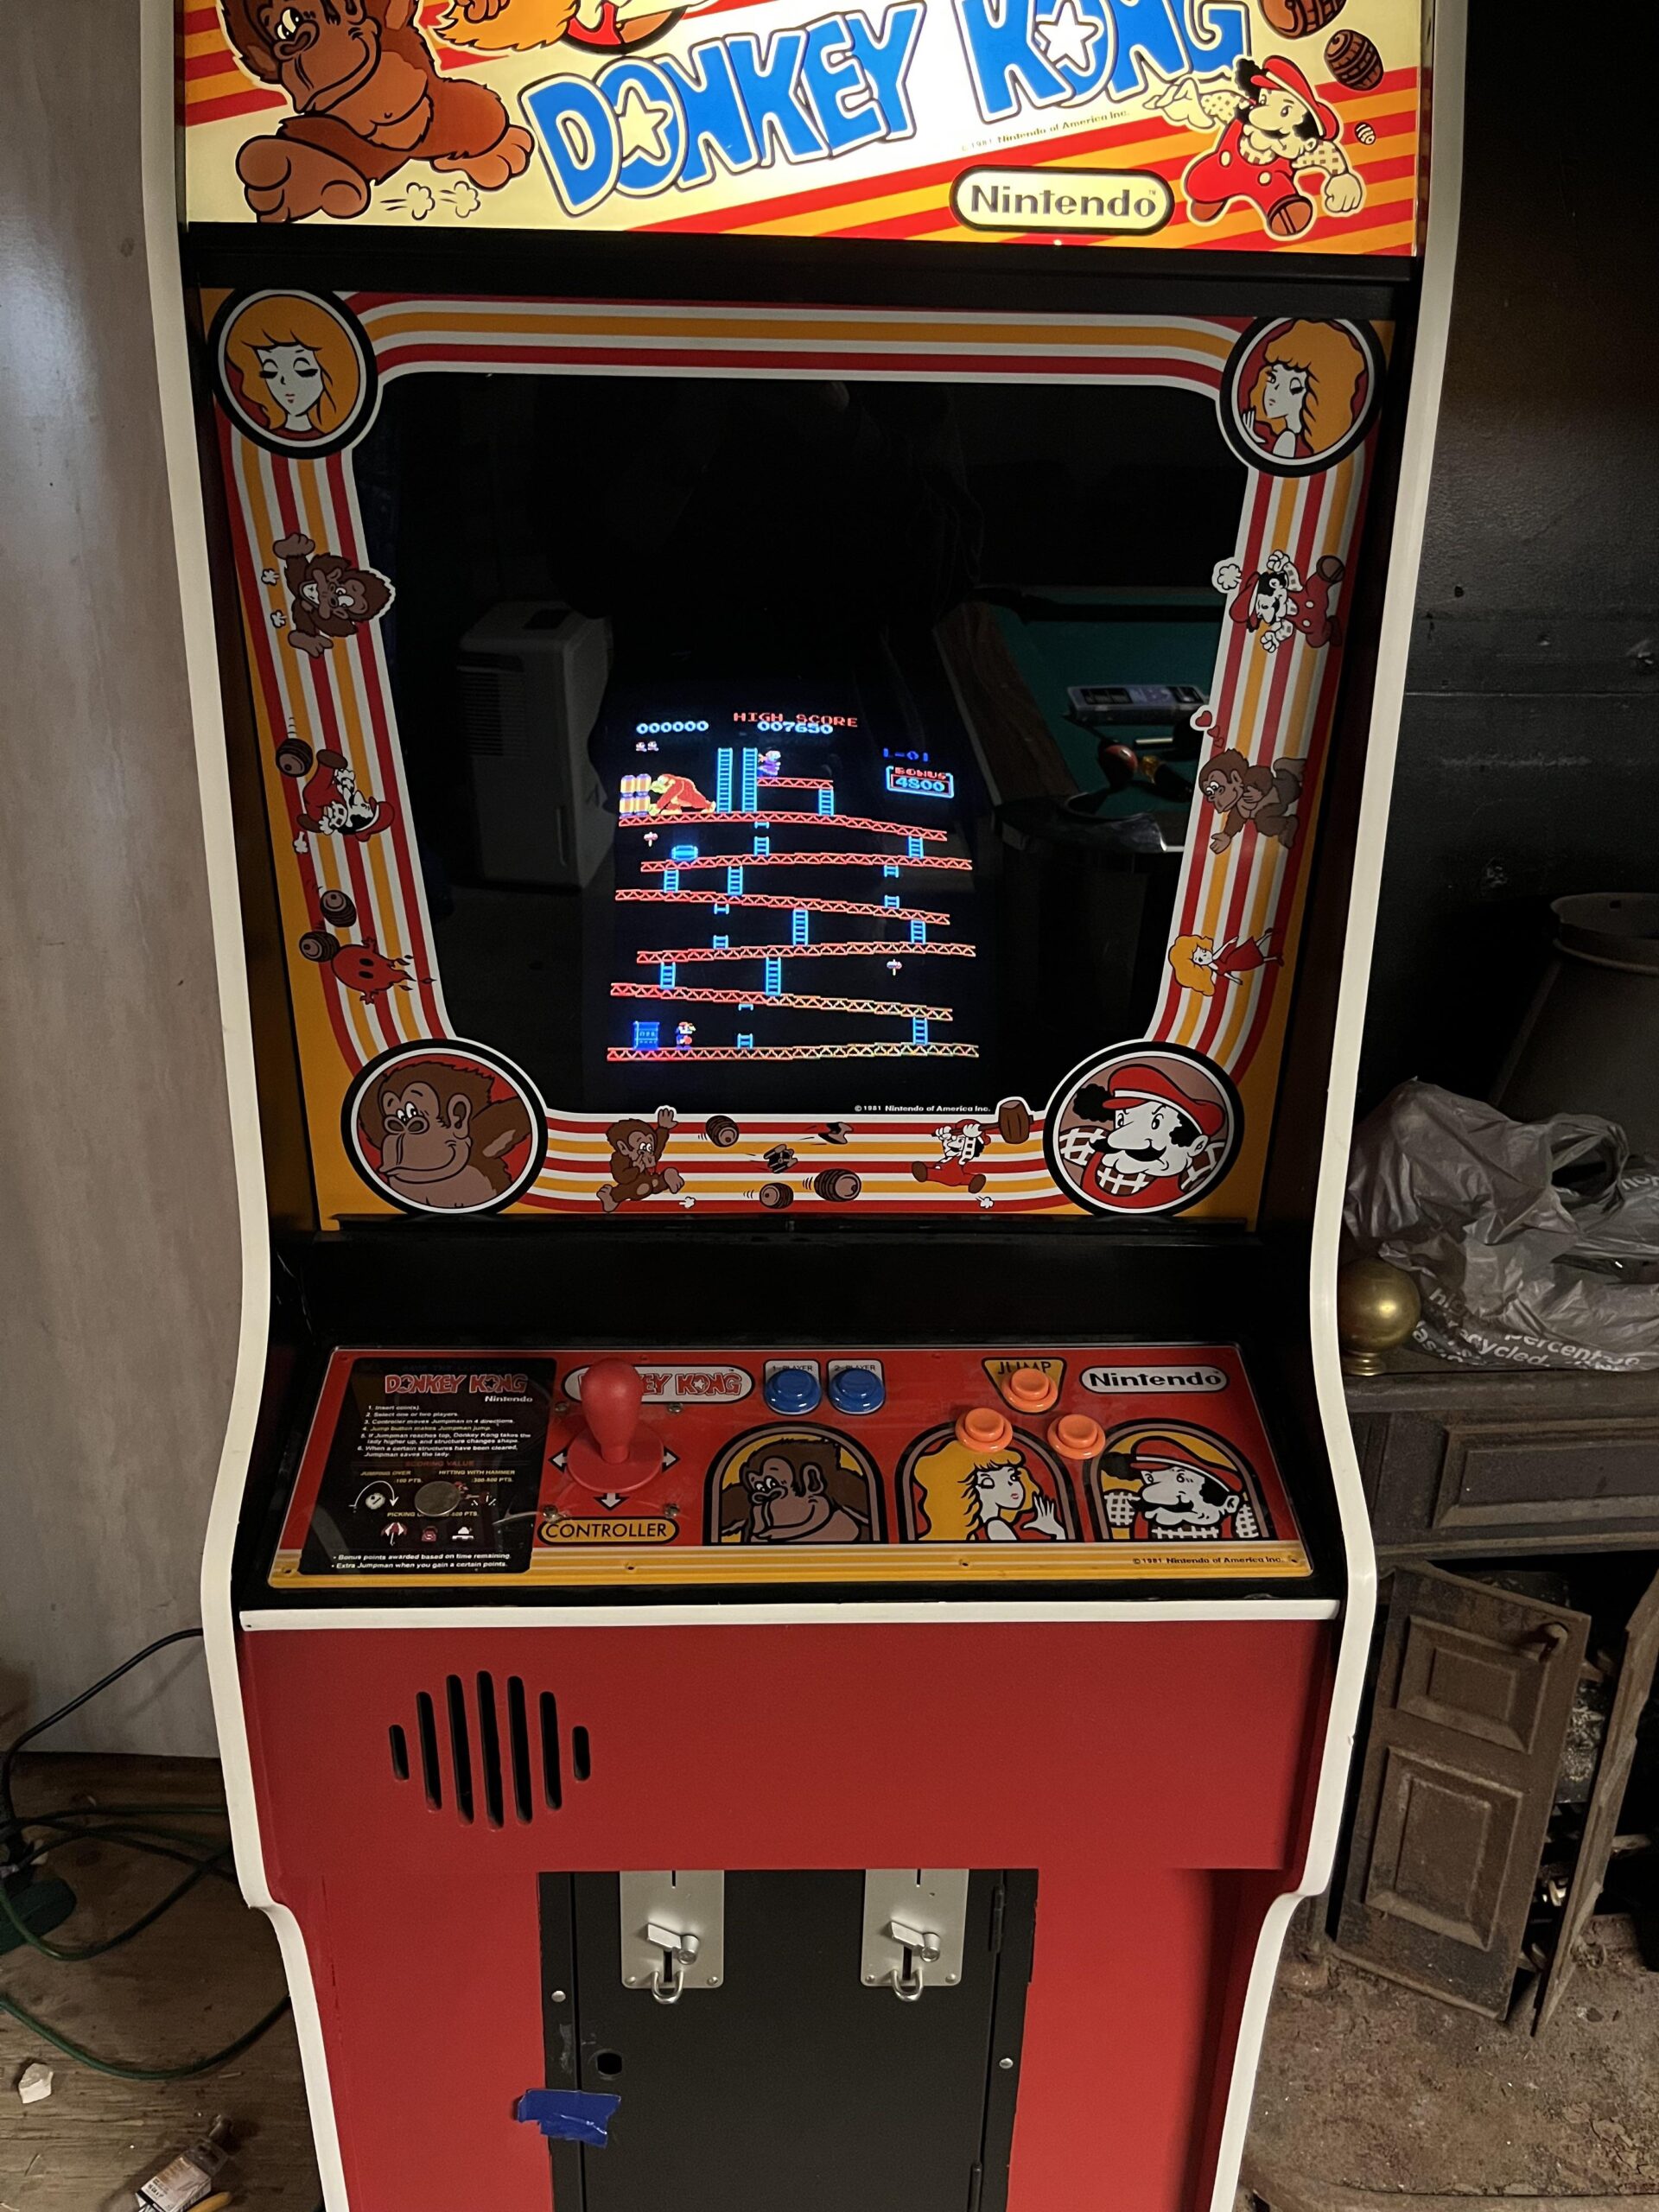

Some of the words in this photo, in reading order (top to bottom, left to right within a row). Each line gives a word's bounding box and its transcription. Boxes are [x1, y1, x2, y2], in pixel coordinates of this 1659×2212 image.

[521, 0, 927, 219] DONKEY
[955, 0, 1249, 124] KONG
[997, 128, 1046, 143] Nintendo
[1050, 123, 1059, 132] of
[1062, 114, 1108, 130] America
[969, 185, 1156, 219] Nintendo
[636, 721, 709, 734] 000000
[733, 712, 784, 724] HIGH
[796, 713, 858, 728] SCORE
[757, 720, 834, 734] 007650
[894, 766, 946, 780] BONUS
[385, 1374, 467, 1394] DONKEY
[469, 1374, 529, 1394] KONG
[676, 1373, 742, 1396] KONG
[1089, 1372, 1222, 1387] Nintendo
[545, 1522, 667, 1538] CONTROLLER
